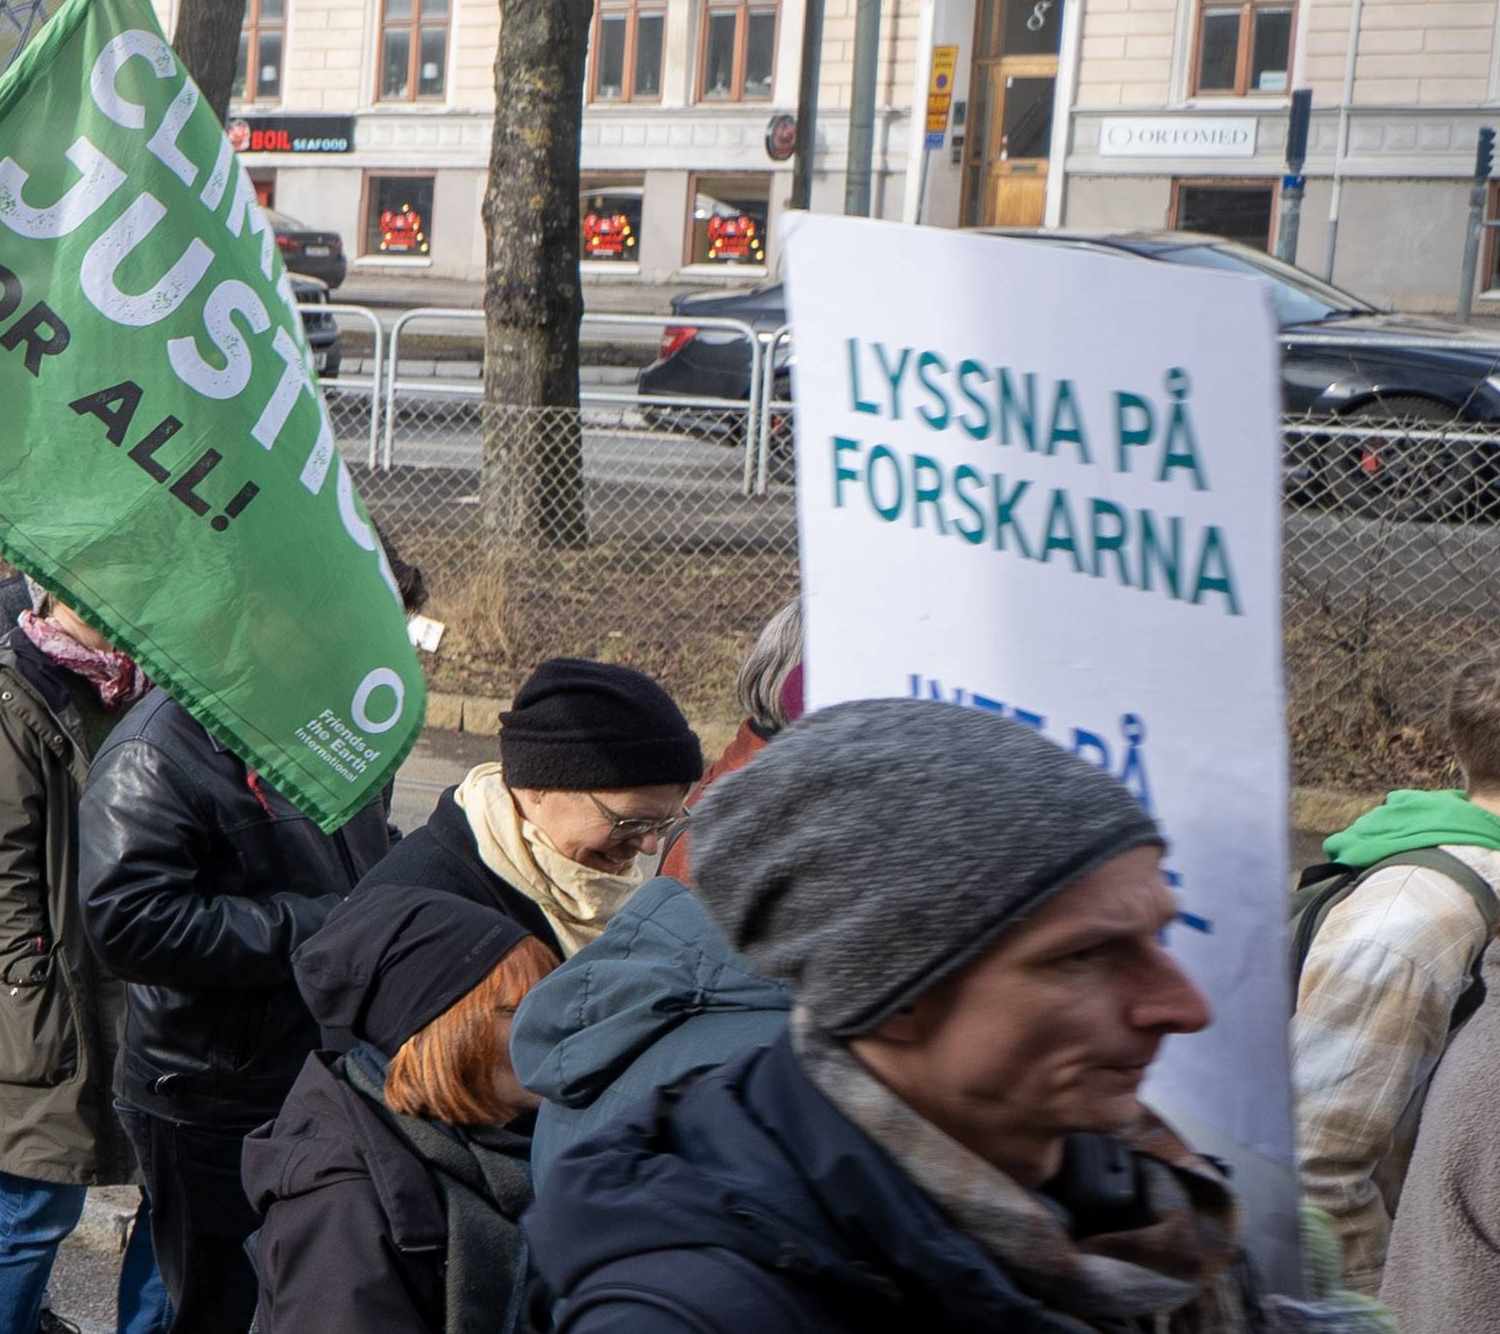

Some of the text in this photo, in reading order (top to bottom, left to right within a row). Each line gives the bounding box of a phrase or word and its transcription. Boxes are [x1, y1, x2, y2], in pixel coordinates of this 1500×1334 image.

[1026, 0, 1052, 31] 8
[251, 129, 348, 151] BOIL SEAFOOD
[1138, 127, 1248, 146] ORTOMED
[845, 336, 1211, 492] LYSSNA PÅ
[68, 380, 262, 533] ALL!
[830, 434, 1246, 617] FORSKARNA
[294, 727, 358, 783] International
[306, 719, 368, 774] the Earth
[319, 708, 381, 763] Friends of
